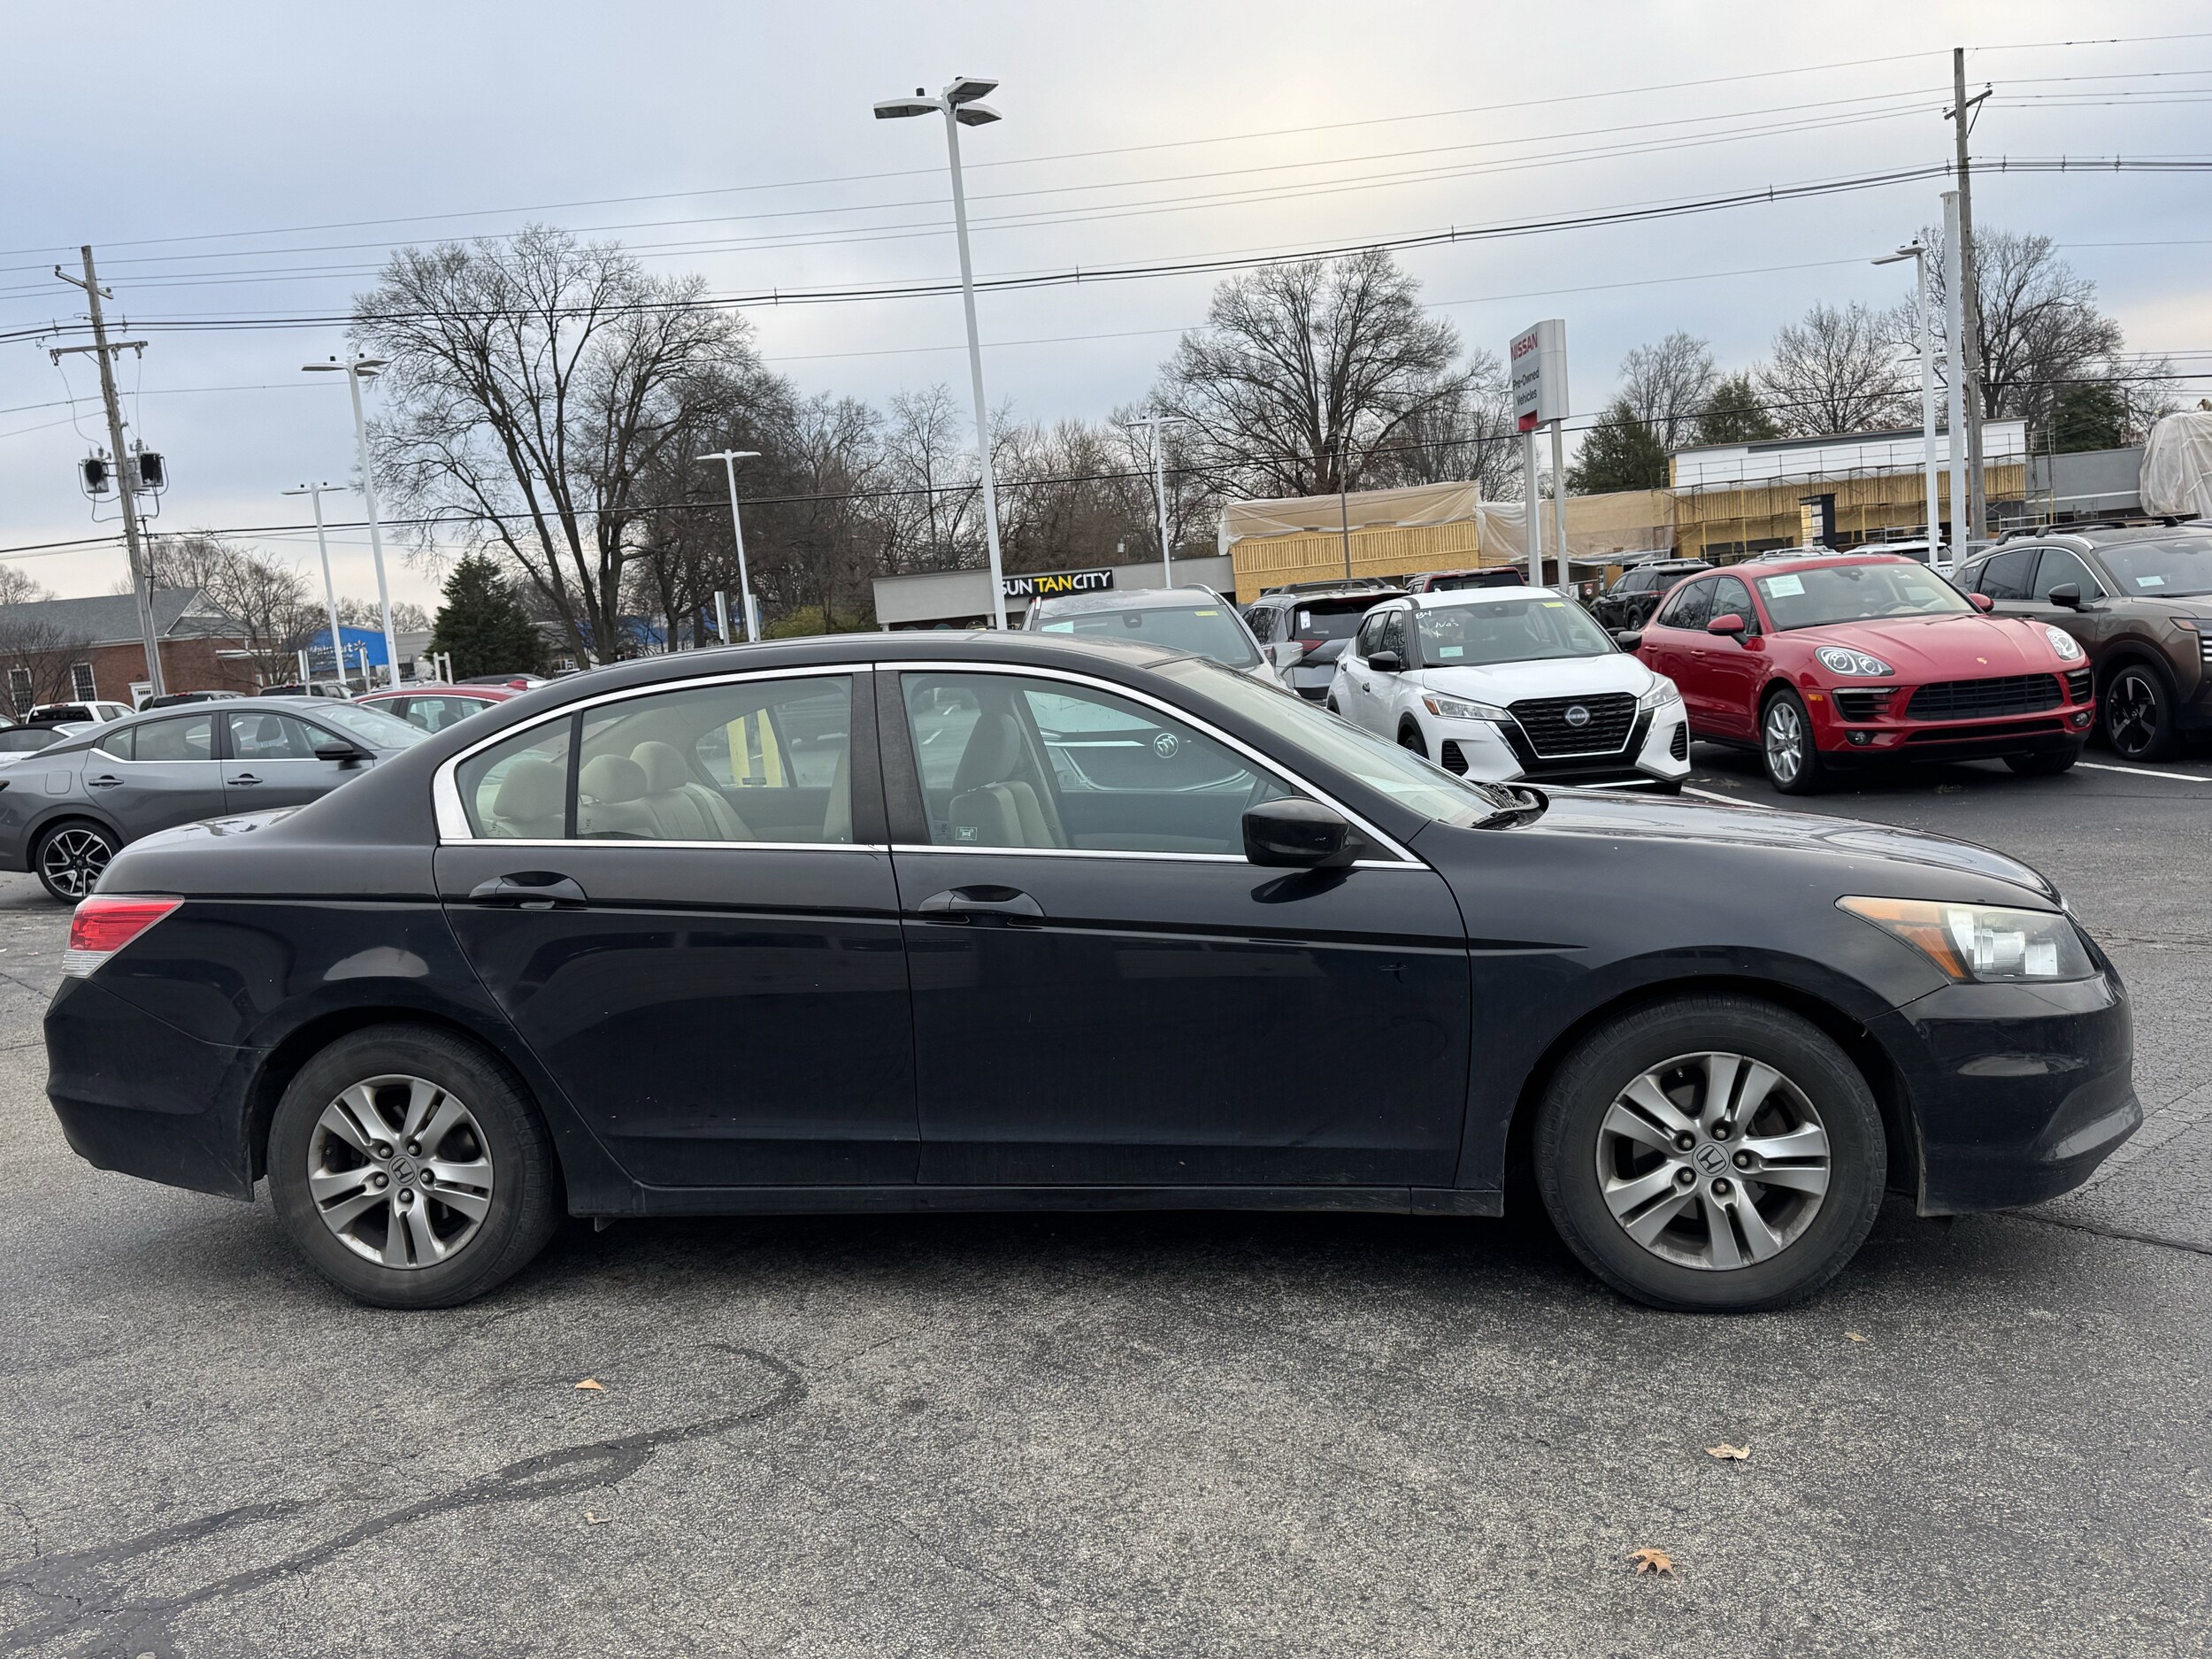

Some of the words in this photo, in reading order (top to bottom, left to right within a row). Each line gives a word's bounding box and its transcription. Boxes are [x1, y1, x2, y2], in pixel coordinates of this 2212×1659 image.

[1510, 332, 1538, 362] NISSAN
[1512, 366, 1540, 390] Pre-Owned
[1517, 389, 1538, 406] Vehicles
